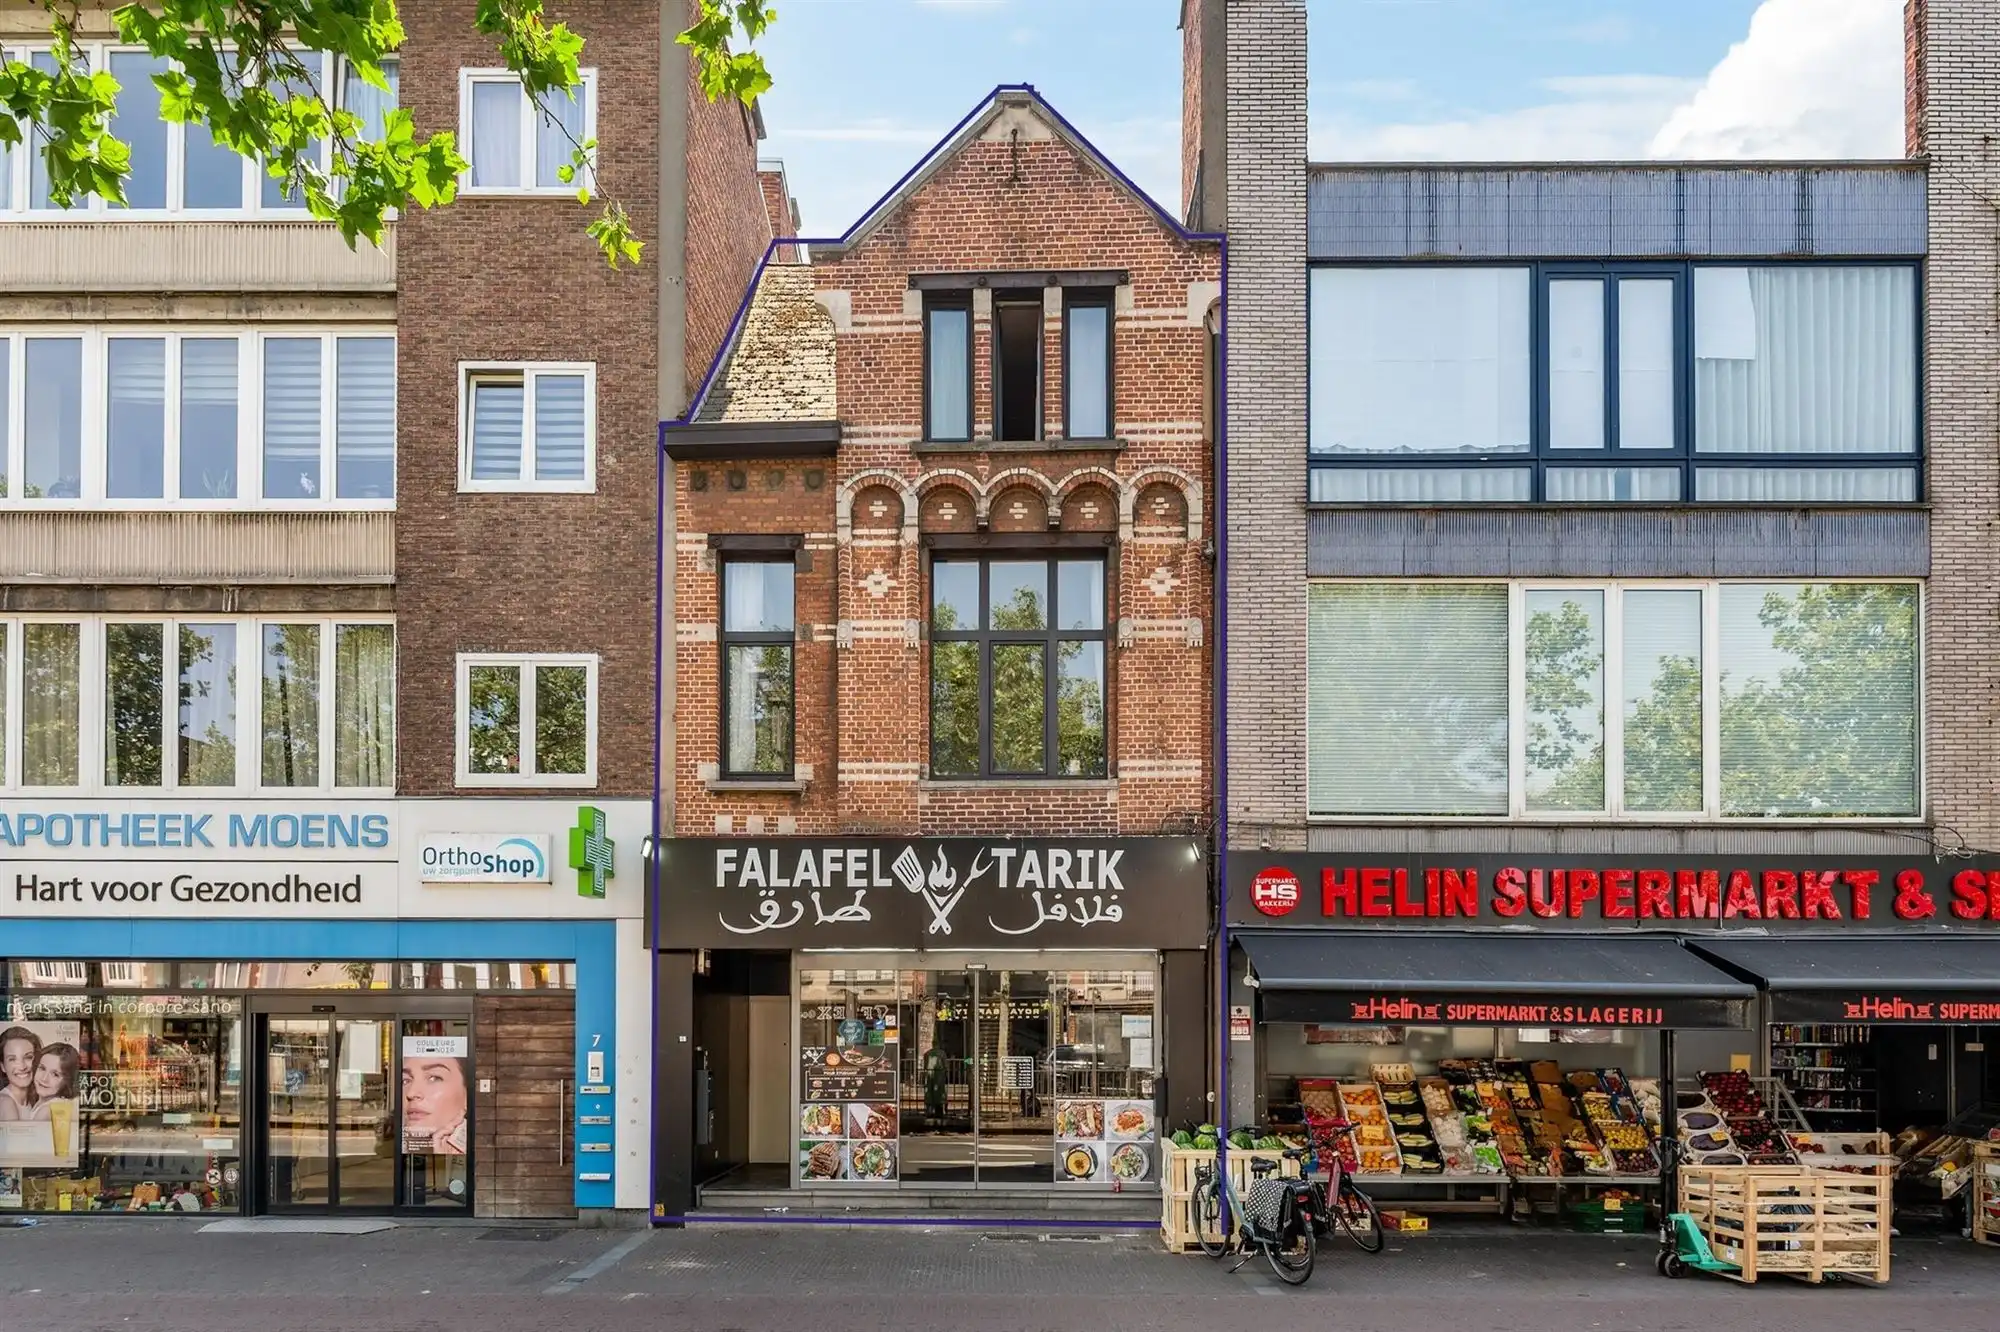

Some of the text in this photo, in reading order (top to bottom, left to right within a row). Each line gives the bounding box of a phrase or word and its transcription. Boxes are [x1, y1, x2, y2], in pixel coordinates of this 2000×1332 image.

[0, 813, 389, 848] APOTHEEK MOENS
[716, 848, 1125, 890] FALAFEL TARIK
[16, 874, 361, 902] Hart voor Gezondheid
[1255, 877, 1298, 885] SUPERMARKT
[1255, 884, 1298, 900] HS
[1321, 867, 1479, 917] HELIN
[1490, 867, 1880, 920] SUPERMARKT
[1894, 868, 1937, 920] &
[718, 889, 1123, 935] فلافل طارق
[7, 999, 232, 1017] mens sana in corpore sano
[1370, 998, 1421, 1019] Helin
[1447, 1004, 1547, 1022] SUPERMARKT
[1563, 1007, 1664, 1024] SLAGERIJ
[1863, 997, 1914, 1018] Helin
[416, 1039, 456, 1047] COULEURS
[416, 1046, 455, 1054] DE NOIR
[592, 1034, 601, 1047] 7
